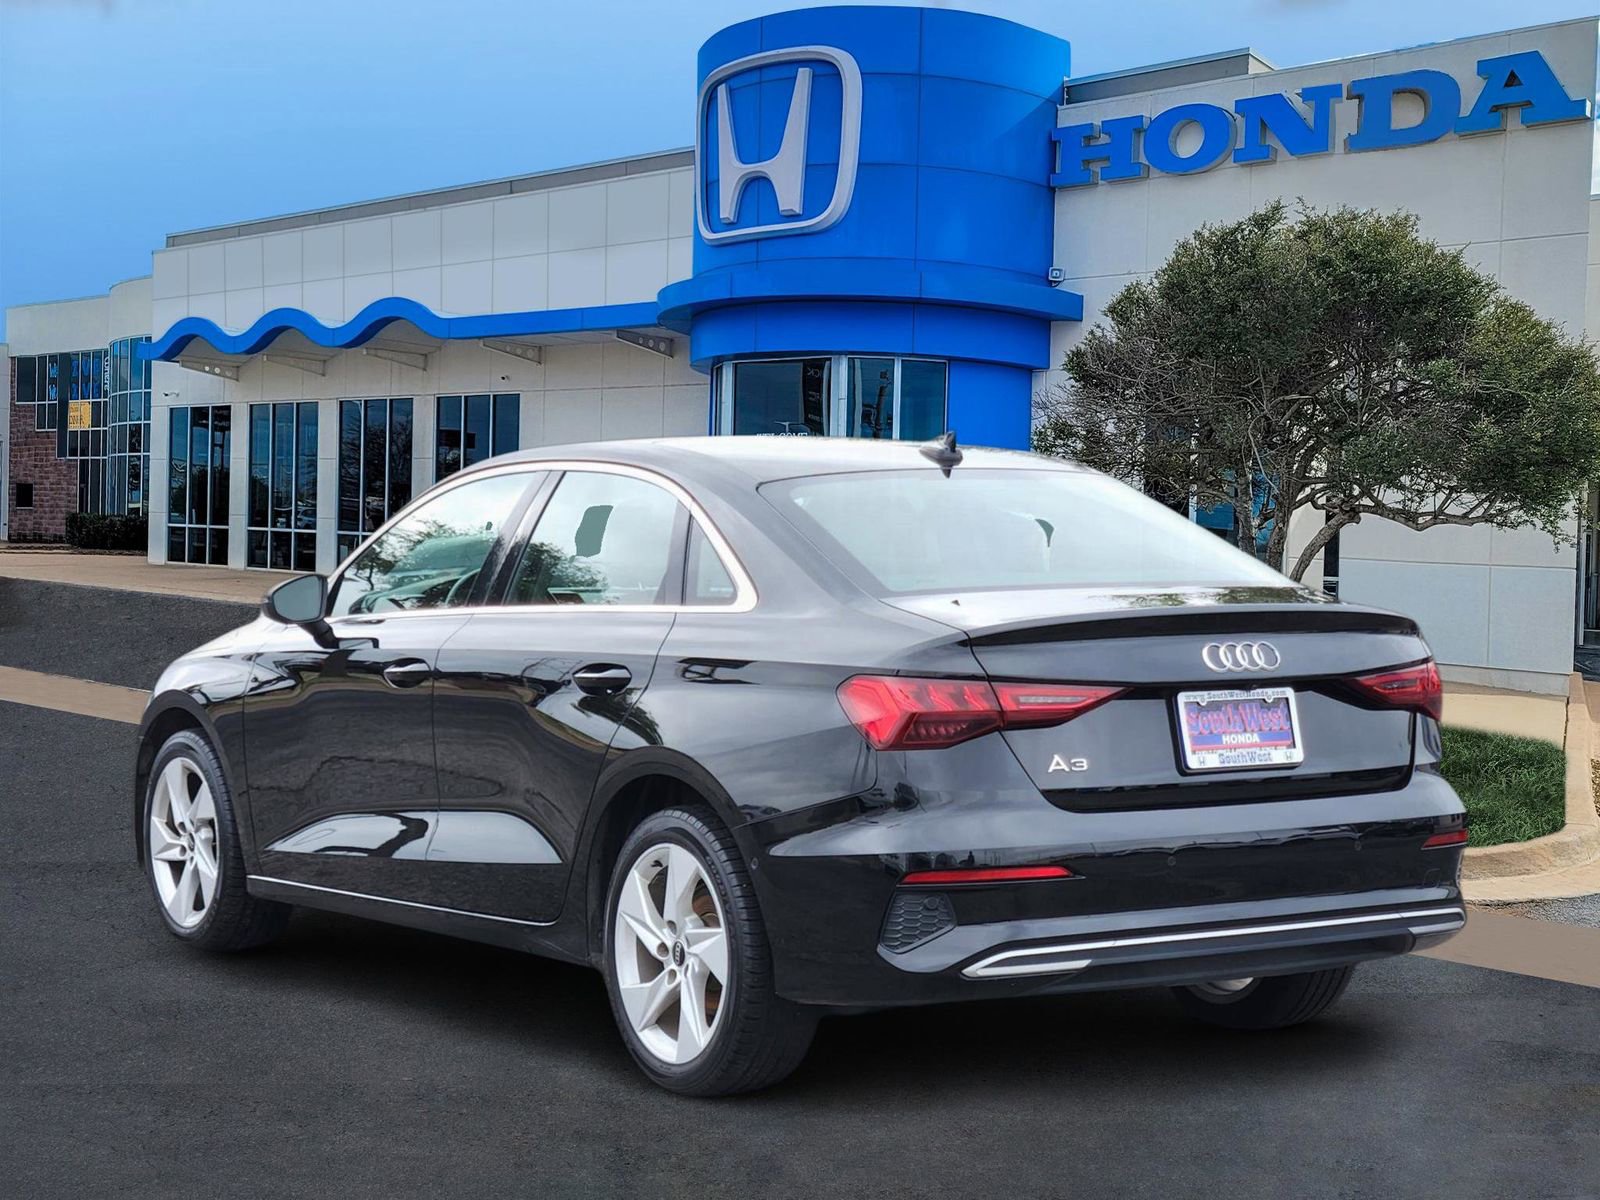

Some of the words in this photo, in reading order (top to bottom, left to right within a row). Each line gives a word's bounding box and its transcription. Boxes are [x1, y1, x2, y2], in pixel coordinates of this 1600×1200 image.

[1051, 50, 1591, 188] HONDA
[1222, 732, 1261, 745] HONDA
[1047, 754, 1088, 773] A3
[1218, 751, 1273, 765] SouthWest
